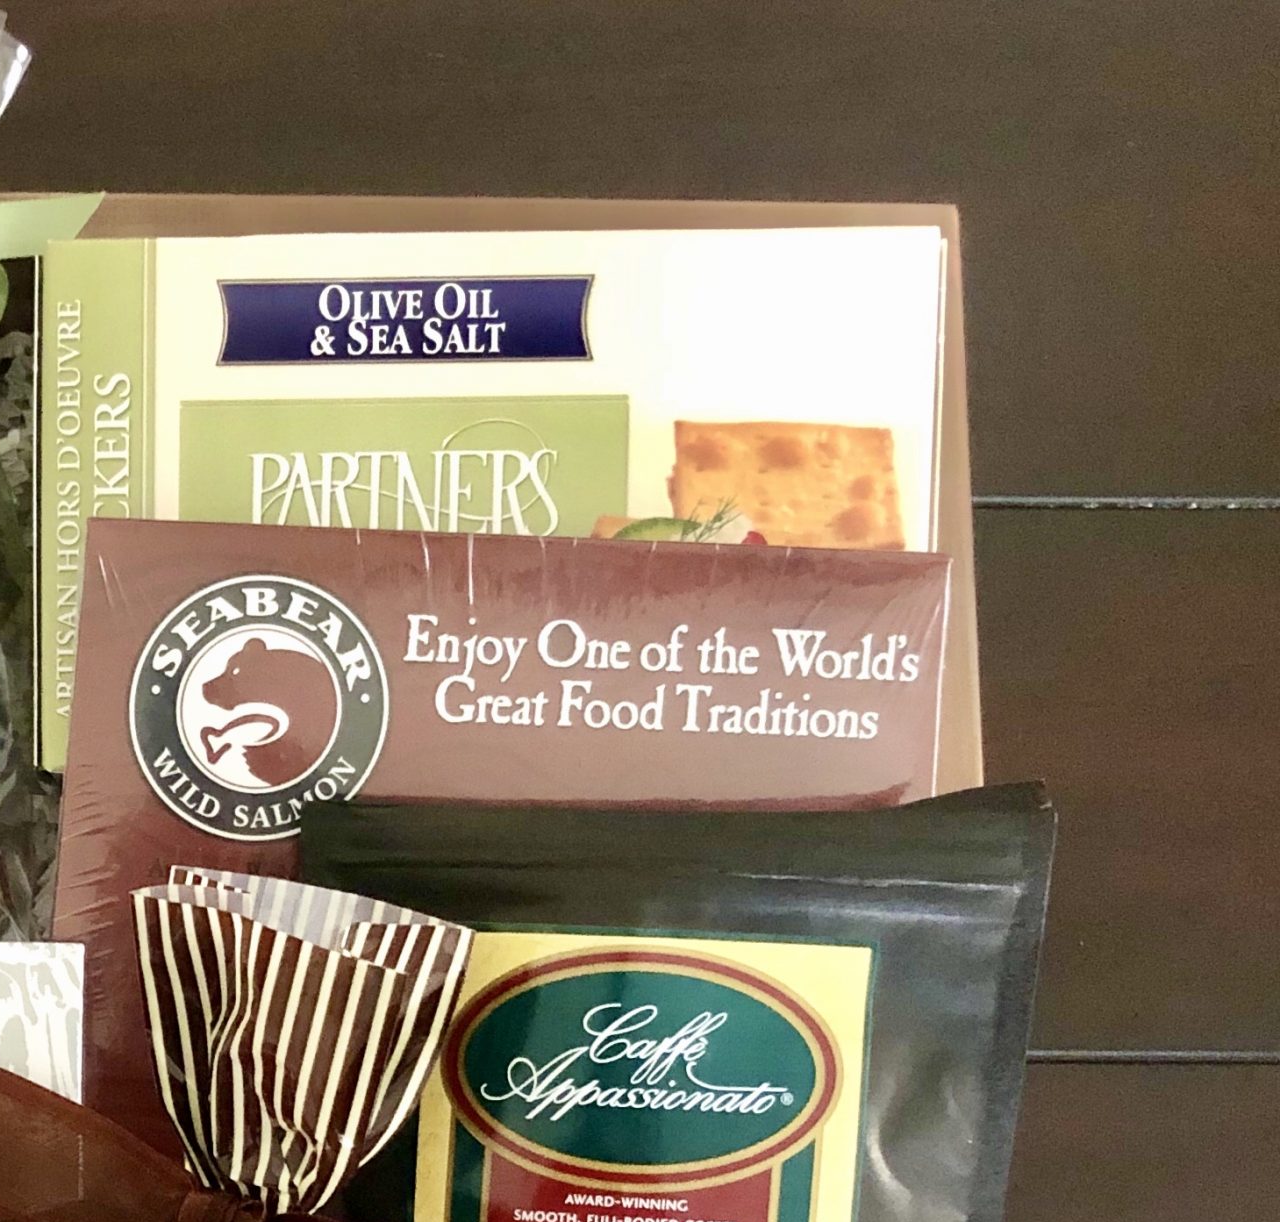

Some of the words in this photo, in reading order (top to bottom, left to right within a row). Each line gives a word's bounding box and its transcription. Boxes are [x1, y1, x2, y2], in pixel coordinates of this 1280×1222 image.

[310, 325, 336, 356] &
[347, 317, 413, 356] SEA
[422, 317, 506, 354] SALT
[319, 284, 424, 321] OLIVE
[434, 283, 499, 320] OIL
[56, 481, 80, 572] HORS
[249, 449, 558, 537] PARTNERS
[56, 584, 78, 717] ARTISAN
[152, 587, 371, 692] SEABEAR
[403, 614, 528, 682] Enjoy
[537, 619, 631, 671] One
[640, 624, 689, 673] of
[697, 627, 759, 675] the
[772, 628, 920, 682] World's
[434, 675, 549, 726] Great
[557, 680, 664, 731] Food
[676, 684, 879, 740] Traditions
[153, 747, 221, 819] WILD
[233, 756, 357, 828] SALMON
[564, 1193, 688, 1212] AWARD-WINNING
